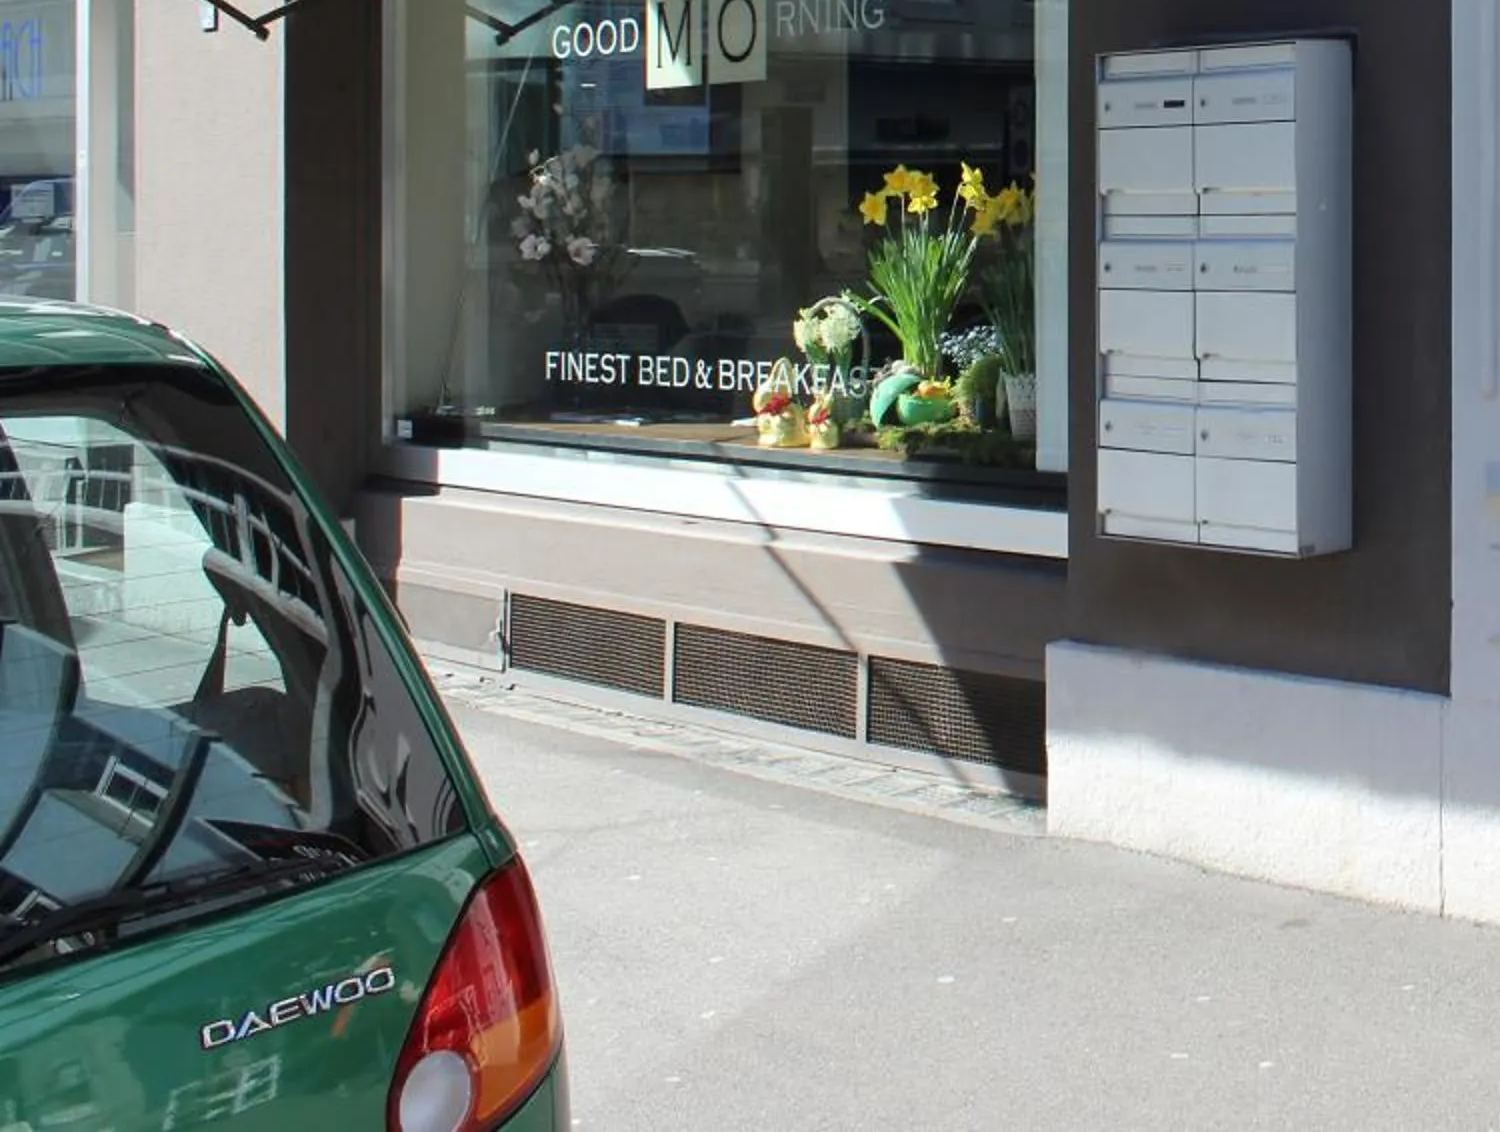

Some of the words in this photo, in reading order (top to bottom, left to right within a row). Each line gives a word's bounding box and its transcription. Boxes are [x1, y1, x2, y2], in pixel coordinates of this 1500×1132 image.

[552, 18, 640, 59] GOOD
[545, 351, 631, 384] FINEST
[638, 355, 690, 388] BED
[694, 359, 713, 390] &
[202, 967, 397, 1048] DAEWOO
